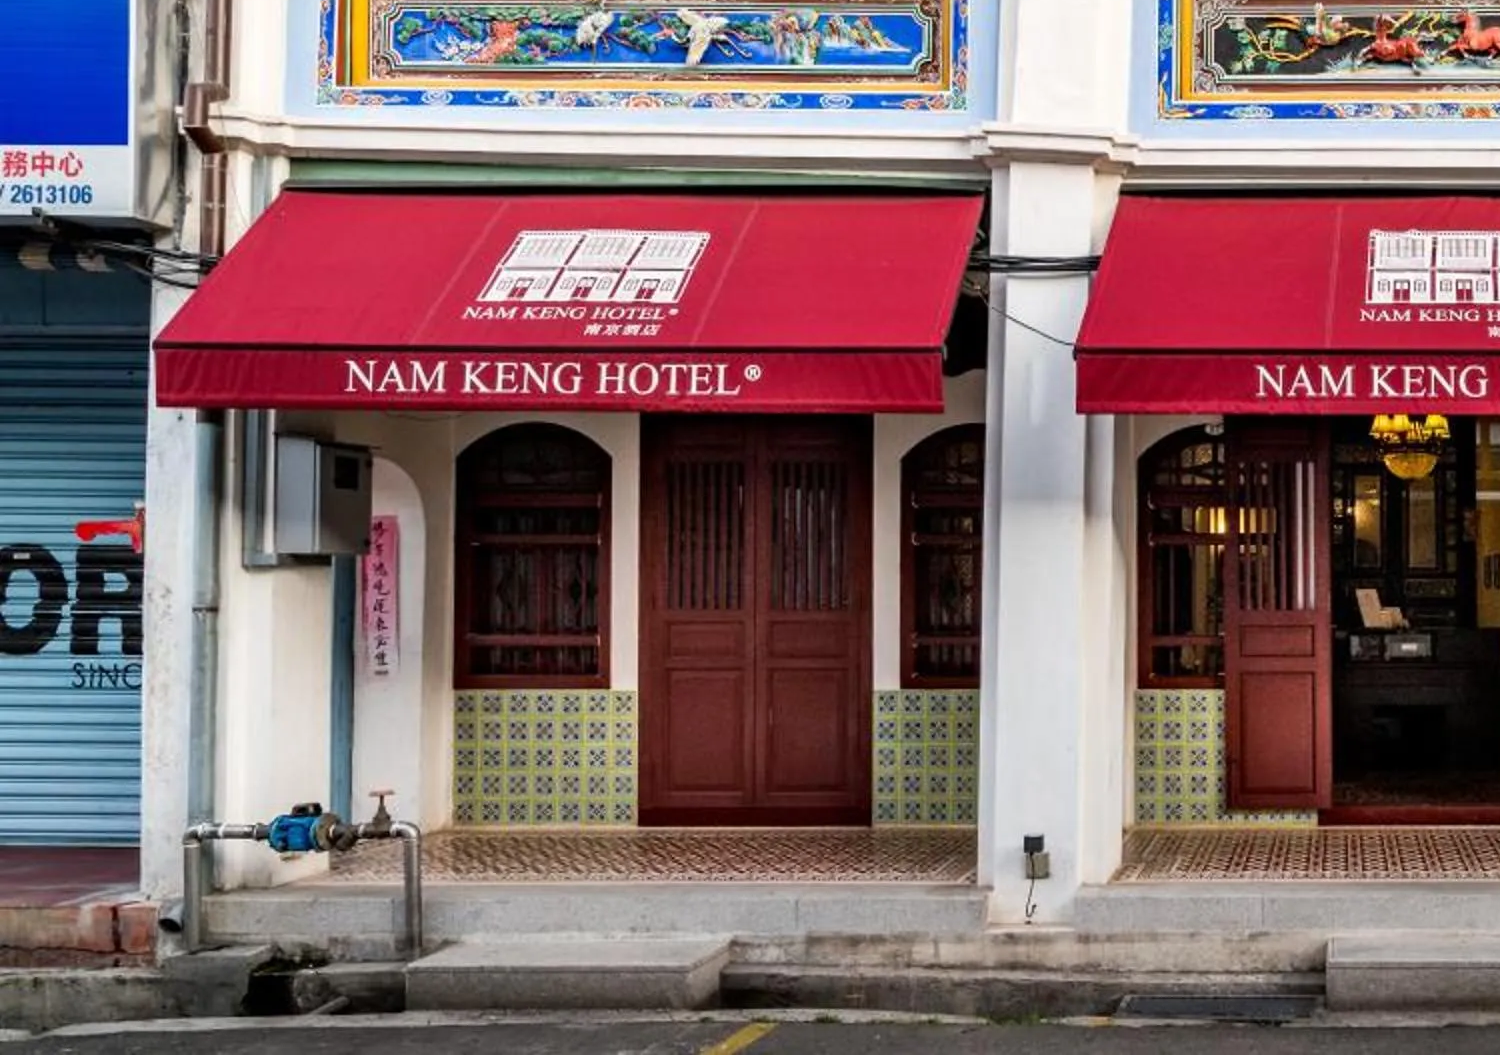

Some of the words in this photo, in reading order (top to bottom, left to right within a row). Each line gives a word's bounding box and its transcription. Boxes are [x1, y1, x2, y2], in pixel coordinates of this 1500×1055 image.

[3, 150, 83, 178] 務中心
[10, 184, 93, 204] 2613106
[461, 306, 516, 320] NAM
[522, 306, 587, 320] KENG
[1360, 308, 1411, 322] NAM
[1419, 308, 1480, 322] KENG
[345, 360, 446, 393] NAM
[462, 361, 582, 394] KENG
[1256, 365, 1354, 398] NAM
[1370, 365, 1488, 398] KENG
